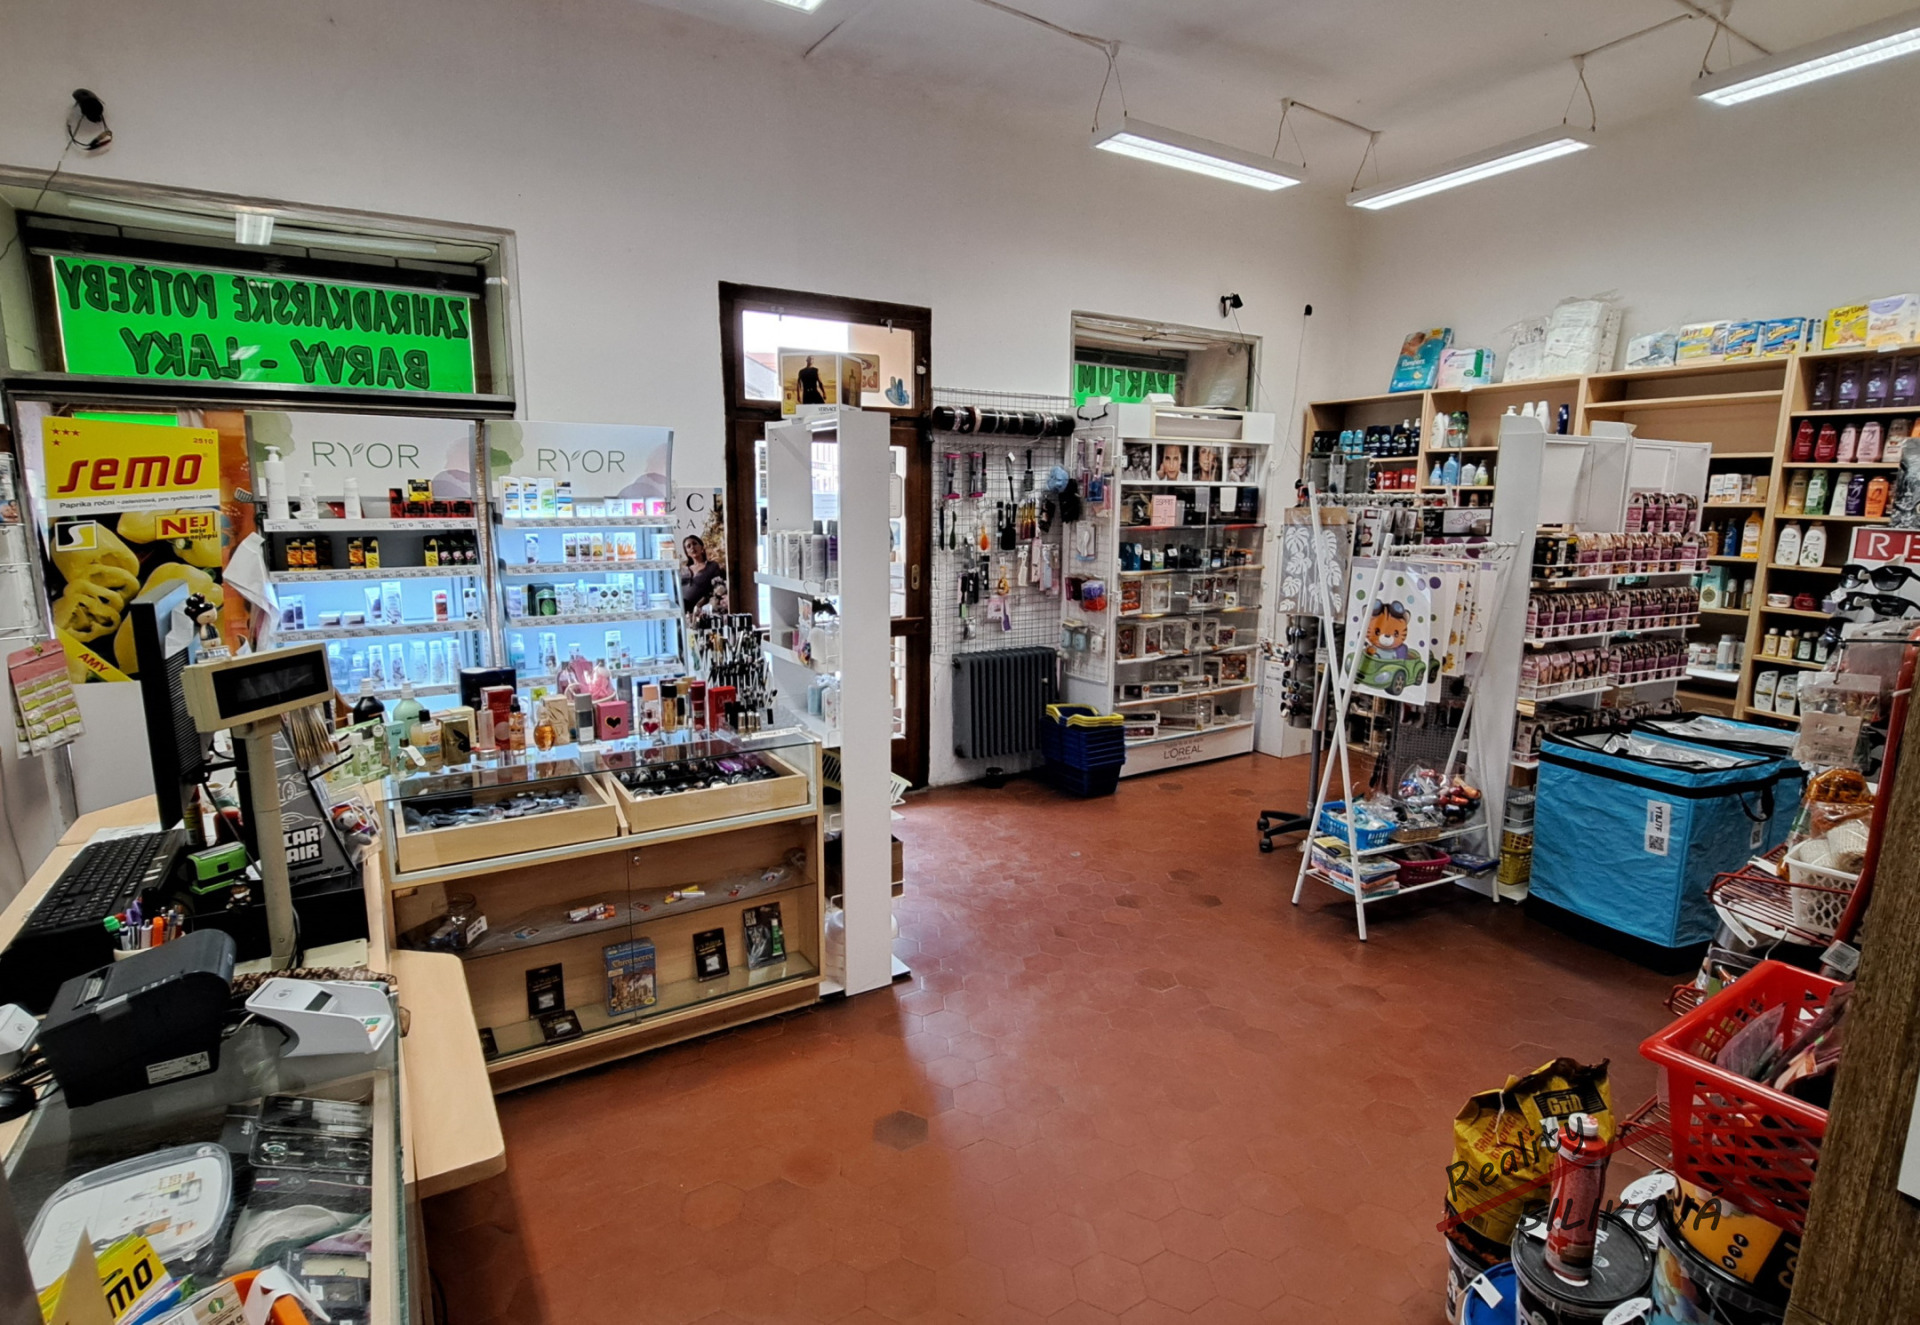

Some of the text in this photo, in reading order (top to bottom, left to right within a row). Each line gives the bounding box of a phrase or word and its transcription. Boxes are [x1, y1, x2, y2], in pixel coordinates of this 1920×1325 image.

[312, 441, 420, 468] RYOR
[537, 448, 625, 473] RYOR
[57, 454, 203, 493] semo
[59, 500, 92, 510] Paprika
[162, 516, 209, 536] NEJ
[78, 653, 109, 672] AMY
[283, 827, 320, 848] CAR
[286, 844, 320, 864] AIR
